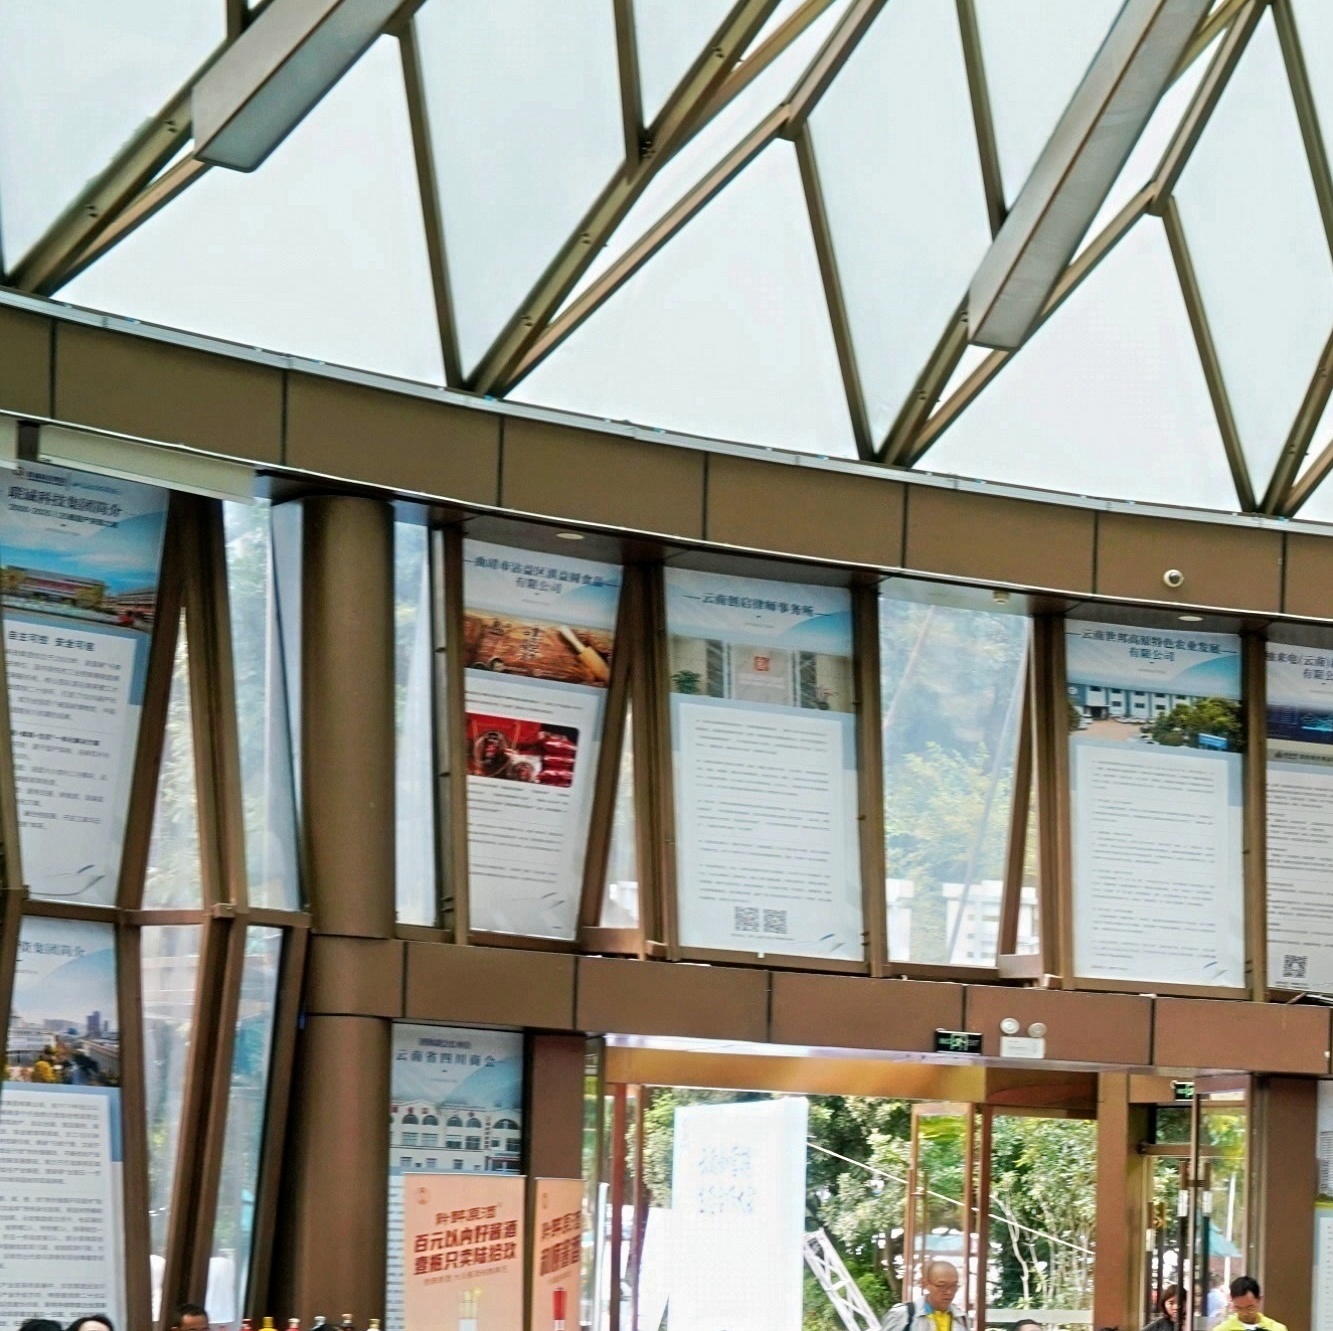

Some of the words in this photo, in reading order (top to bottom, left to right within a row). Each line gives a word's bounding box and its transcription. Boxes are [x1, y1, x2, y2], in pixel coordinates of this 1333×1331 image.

[516, 577, 562, 594] 有限公司
[1129, 647, 1175, 661] 有限公司
[396, 1049, 496, 1067] 云南省四川商会
[414, 1219, 518, 1253] 百元以内好酱酒
[413, 1241, 517, 1275] 壹瓶只卖陆拾玖
